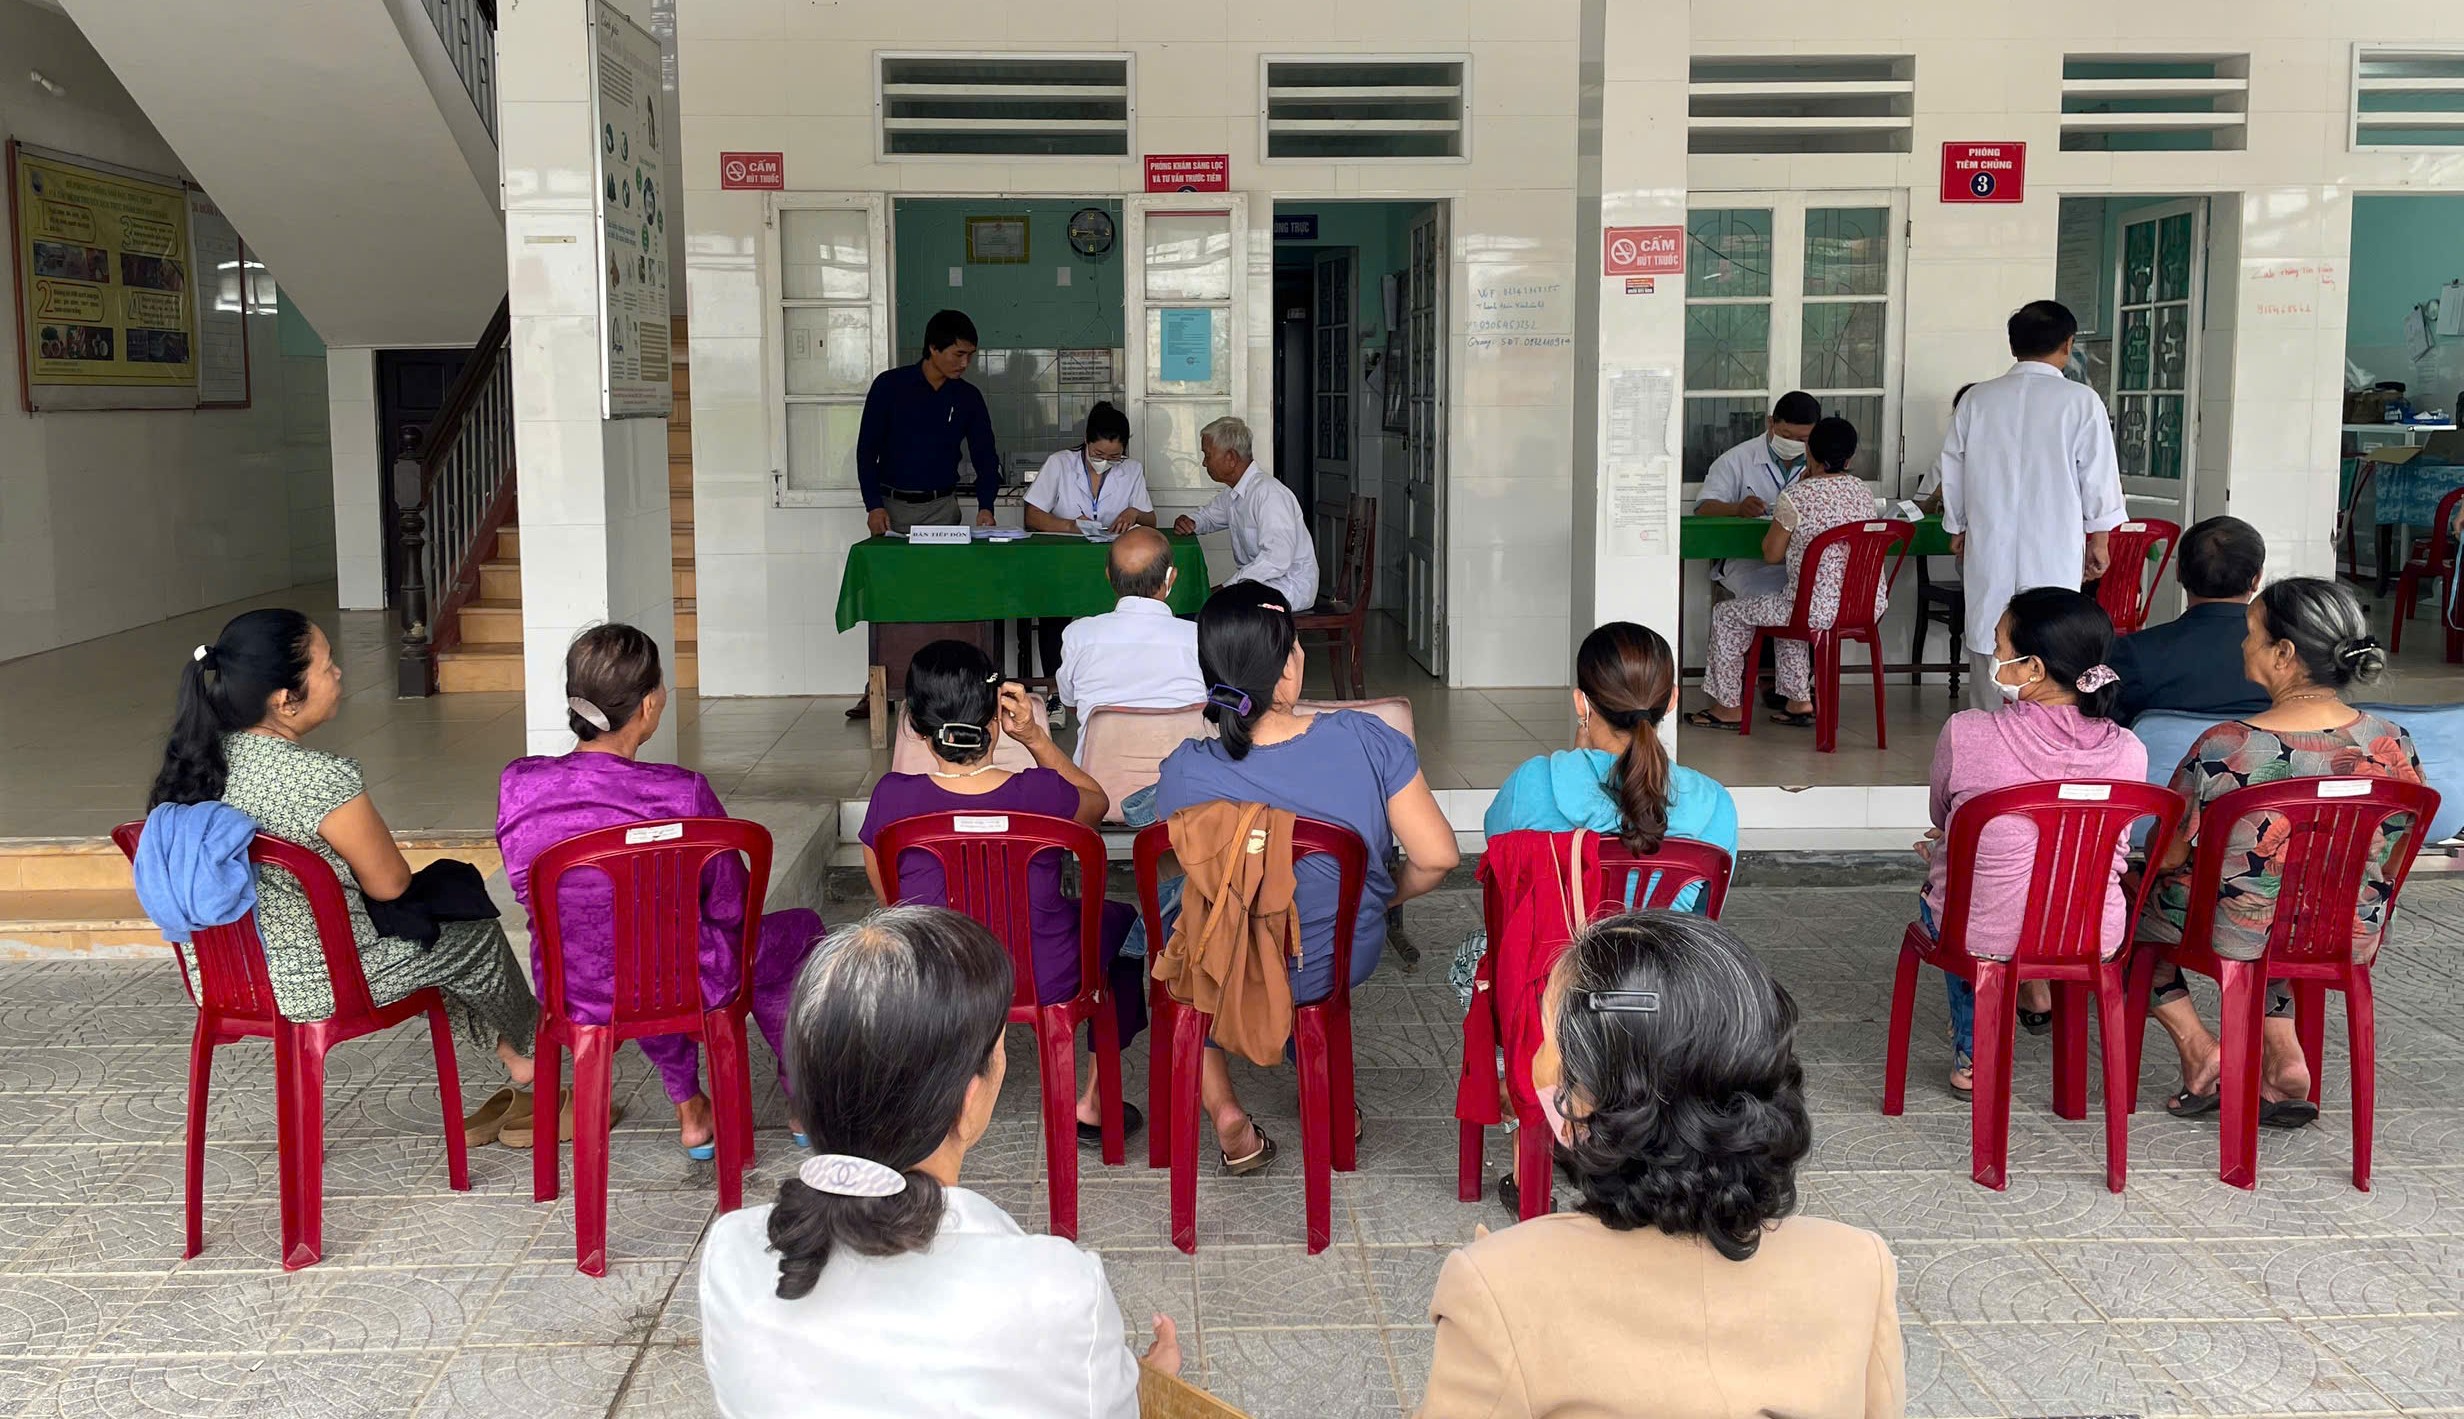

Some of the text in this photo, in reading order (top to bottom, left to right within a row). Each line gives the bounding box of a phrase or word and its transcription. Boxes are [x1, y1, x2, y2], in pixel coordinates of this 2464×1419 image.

[1968, 146, 2001, 157] PHÒNG
[748, 159, 777, 172] CẤM
[1150, 160, 1172, 171] PHÒNG
[1172, 160, 1192, 170] KHÁM
[1211, 160, 1224, 171] LỌC
[1955, 158, 2013, 170] TIÊM CHỦNG
[1152, 173, 1161, 183] VÀ
[1171, 172, 1184, 183] VẤN
[1185, 172, 1206, 183] TRƯỚC
[1206, 172, 1222, 182] TIÊM
[1977, 175, 1988, 192] 3
[1640, 235, 1675, 252] CẤM
[1636, 252, 1679, 267] HÚT THUỐC
